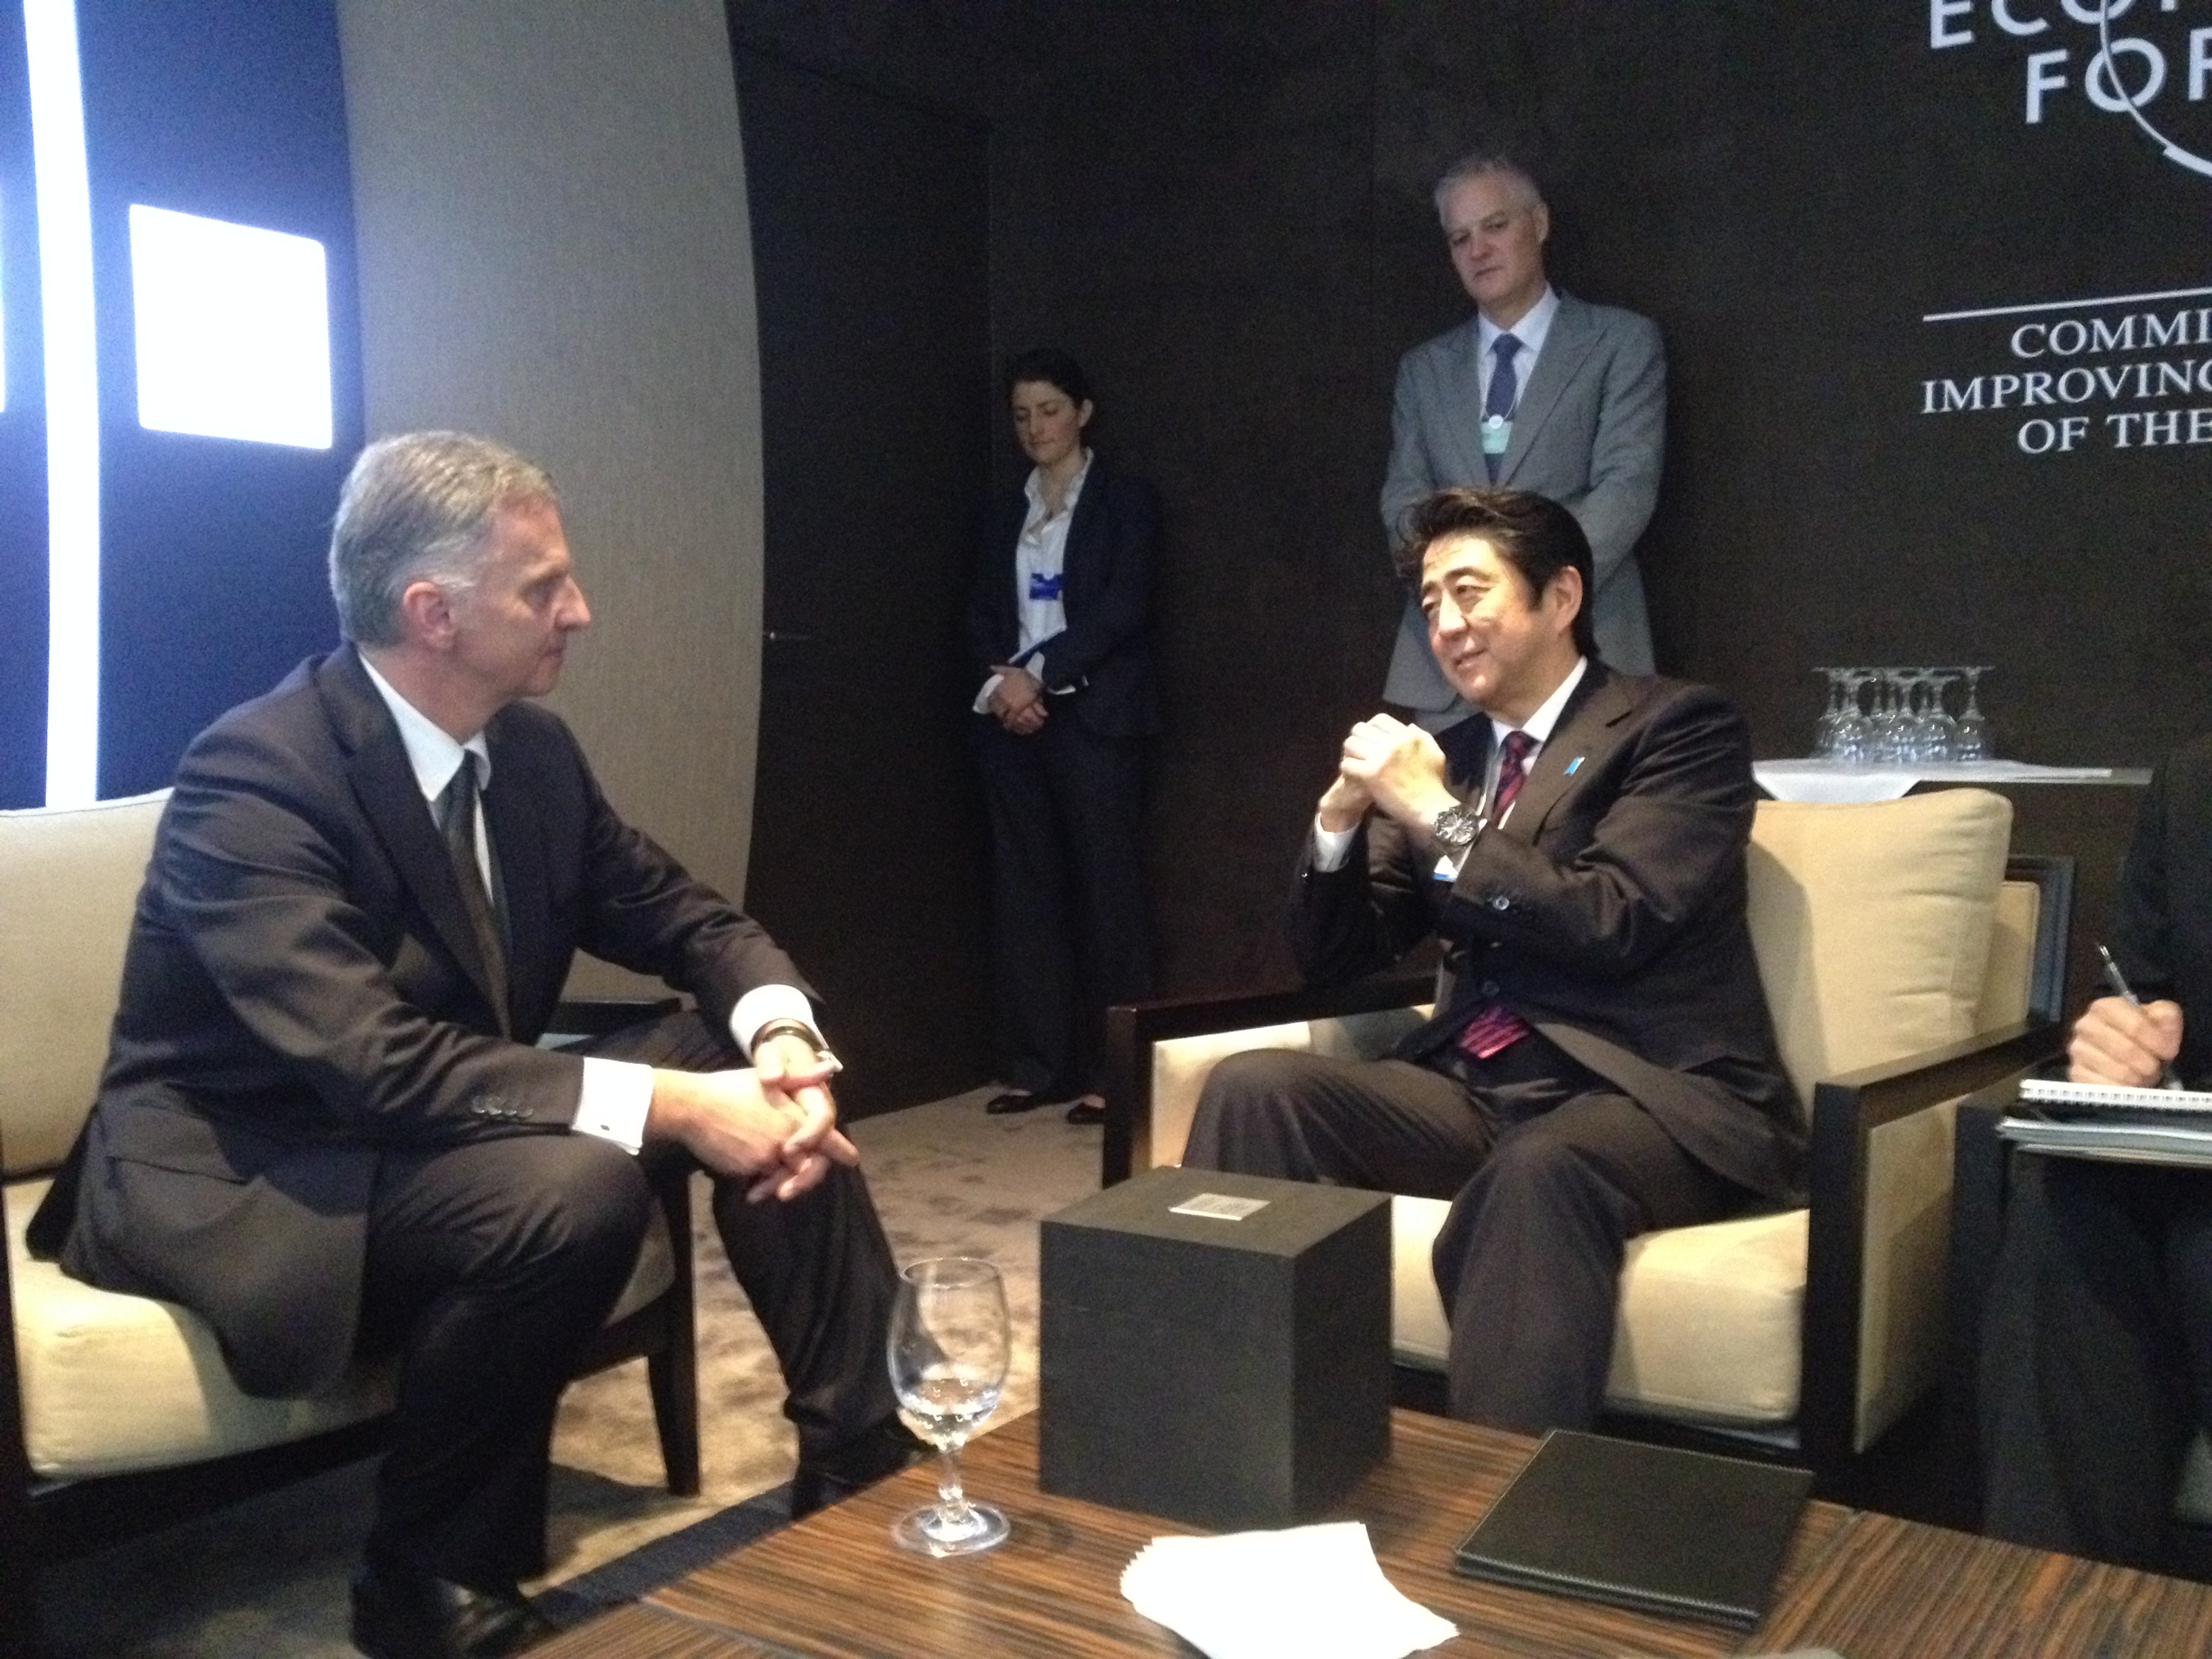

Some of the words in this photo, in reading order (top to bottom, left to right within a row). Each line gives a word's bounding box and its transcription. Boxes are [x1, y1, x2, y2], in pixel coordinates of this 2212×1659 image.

[1931, 0, 2177, 49] EC
[2011, 308, 2212, 359] COMMI
[2017, 416, 2090, 454] OF
[2105, 408, 2212, 449] THE
